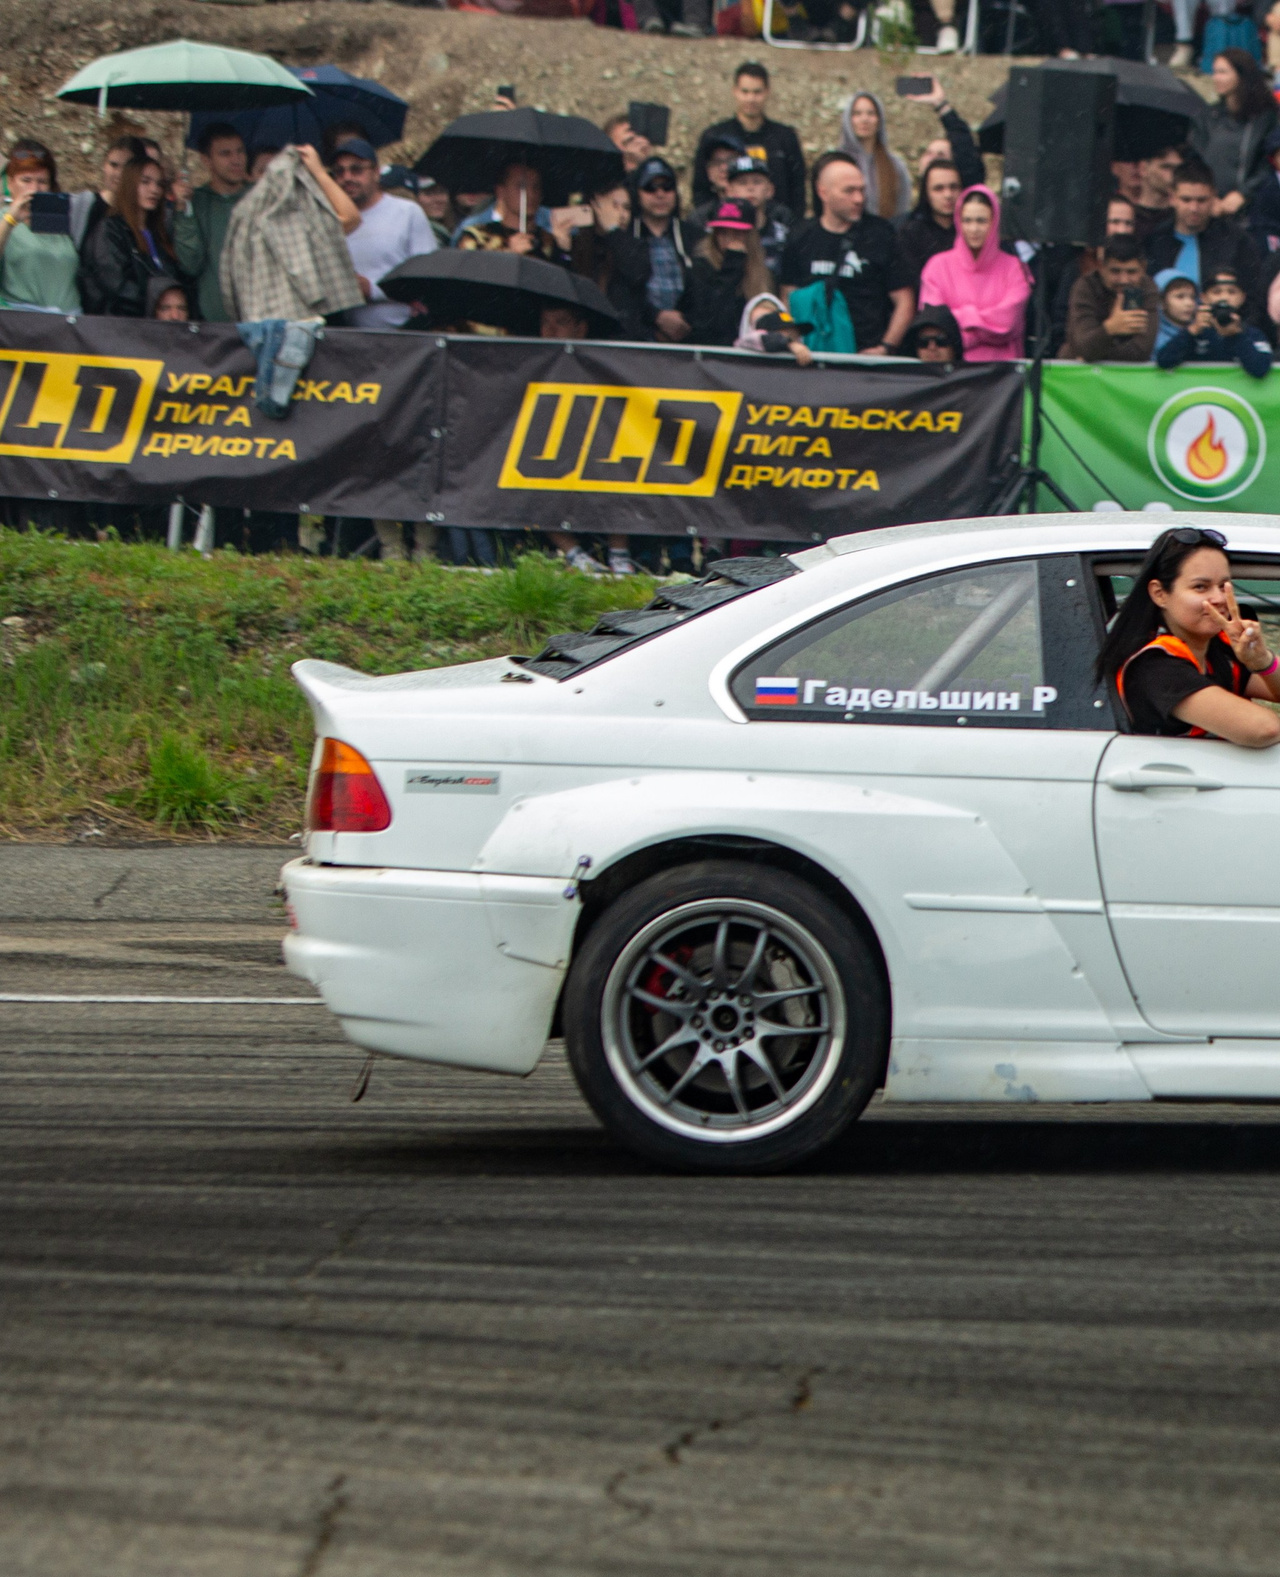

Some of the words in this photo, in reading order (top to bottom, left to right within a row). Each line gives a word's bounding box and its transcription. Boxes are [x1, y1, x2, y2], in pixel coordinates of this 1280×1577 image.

[166, 372, 381, 404] УРАЛКАЯ
[0, 361, 143, 452] LD
[154, 402, 252, 427] ЛИГА
[746, 404, 963, 433] УРАЛЬСКАЯ
[142, 432, 297, 460] ДРИФТА
[516, 393, 724, 485] ULD
[733, 433, 832, 458] ЛИГА
[724, 465, 880, 491] ДРИФТА
[802, 679, 1020, 712] Гадельшин
[1032, 686, 1057, 711] Р
